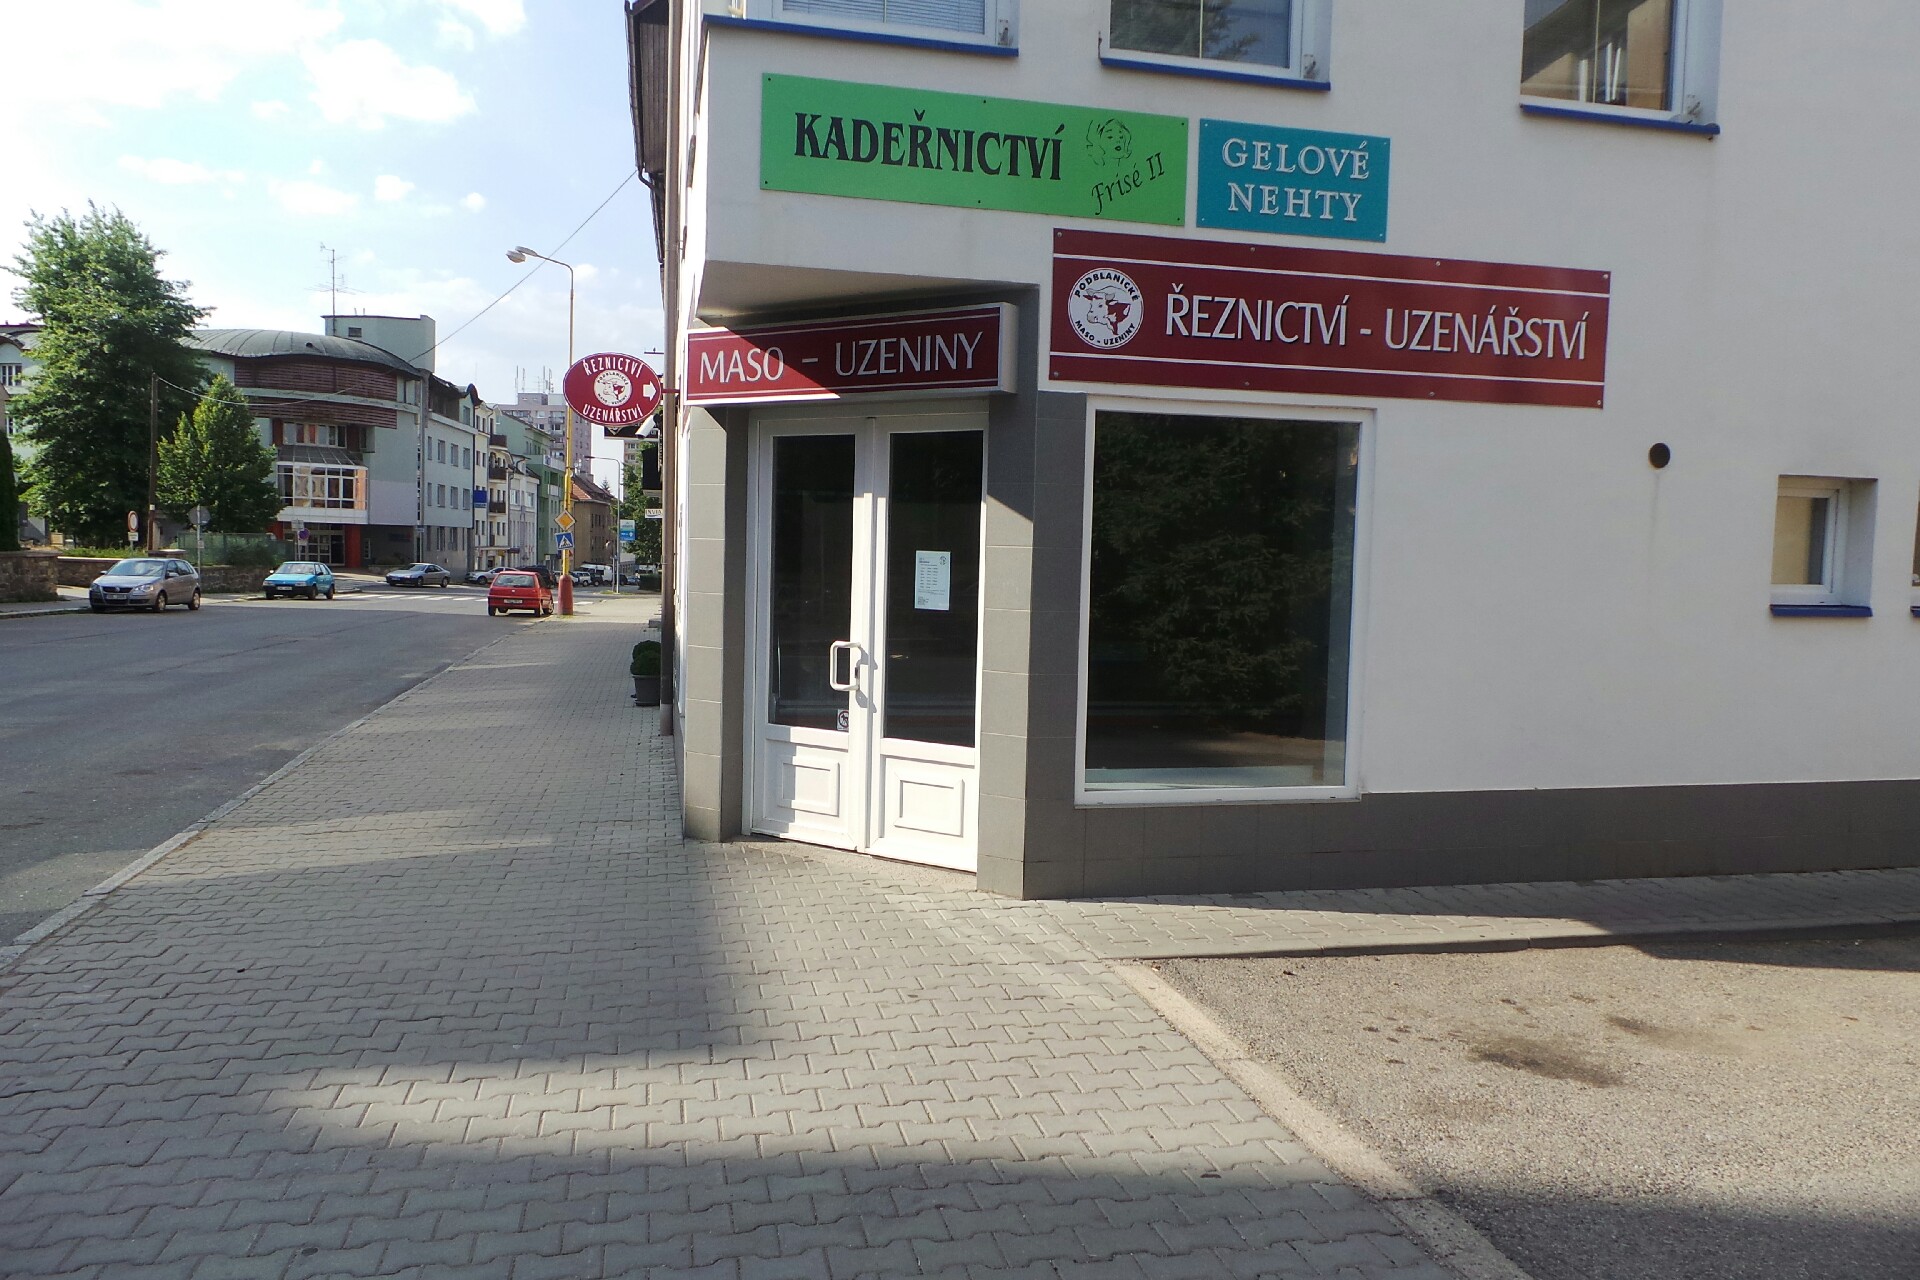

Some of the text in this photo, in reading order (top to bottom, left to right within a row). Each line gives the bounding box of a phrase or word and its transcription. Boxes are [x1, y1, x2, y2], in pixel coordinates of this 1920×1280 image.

[794, 109, 1065, 180] KADEŘNICTVÍ
[1222, 140, 1369, 180] GELOVÉ
[1091, 163, 1143, 215] Frisé
[1228, 182, 1362, 221] NEHTY
[1074, 272, 1140, 301] PODBLANICKÉ
[1075, 320, 1095, 341] MASO
[1103, 322, 1136, 345] UZENINY
[1165, 282, 1350, 346] ŘEZNICTVÍ
[1385, 304, 1590, 360] UZENÁŘSTVÍ
[582, 356, 644, 378] ŘEZNICTVÍ
[699, 346, 784, 384] MASO
[835, 331, 983, 376] UZENINY
[582, 403, 644, 423] UZENÁŘSTVÍ
